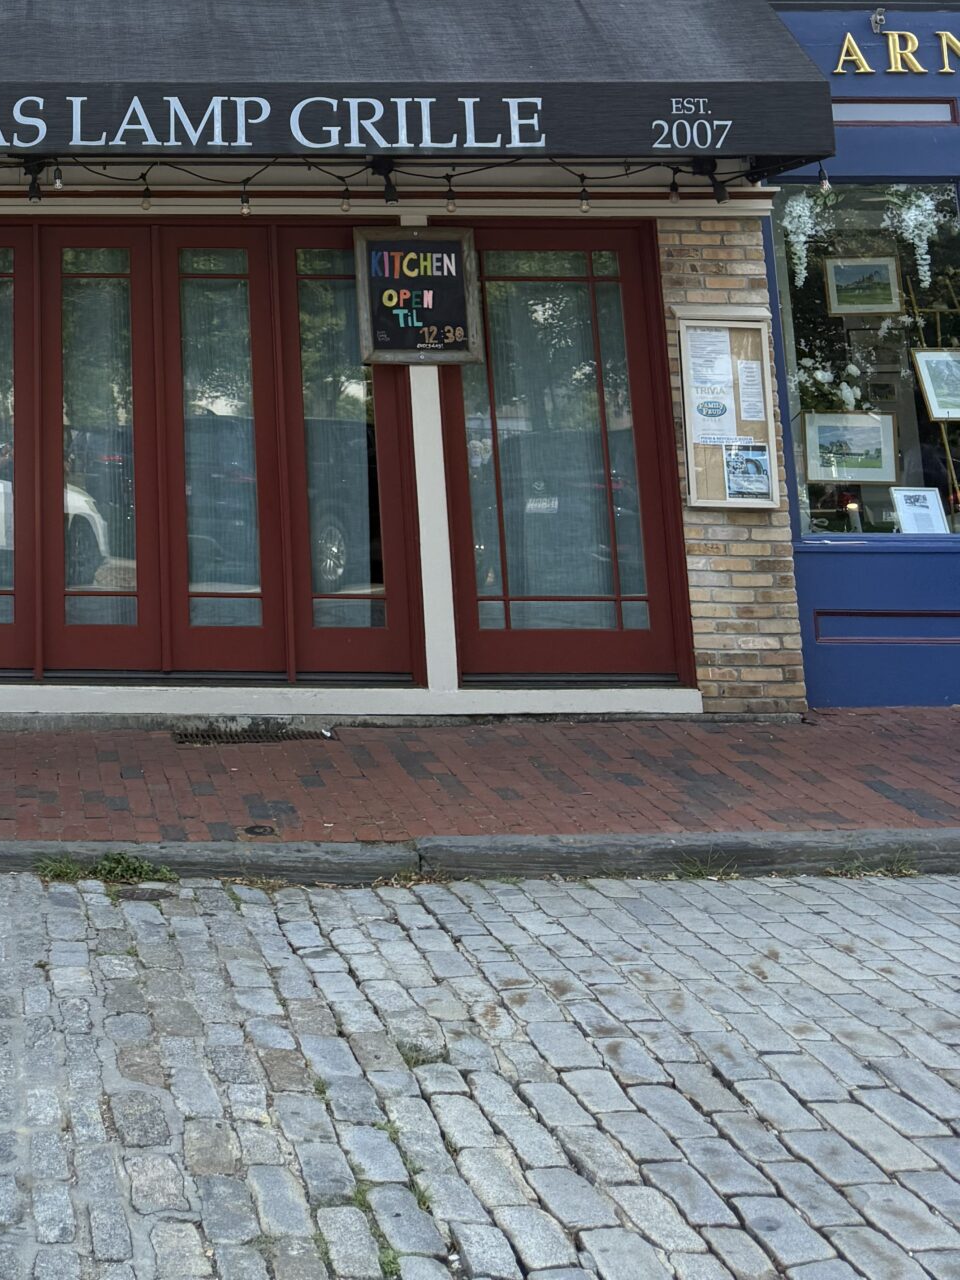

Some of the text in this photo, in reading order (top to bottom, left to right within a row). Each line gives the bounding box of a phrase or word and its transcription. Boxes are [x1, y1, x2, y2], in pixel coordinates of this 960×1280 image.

[671, 98, 712, 114] EST.
[66, 95, 271, 147] LAMP
[289, 96, 546, 148] GRILLE
[651, 120, 733, 149] 2007
[371, 251, 456, 279] KITCHEN
[382, 289, 433, 309] OPEN
[695, 386, 726, 395] TRIVIA
